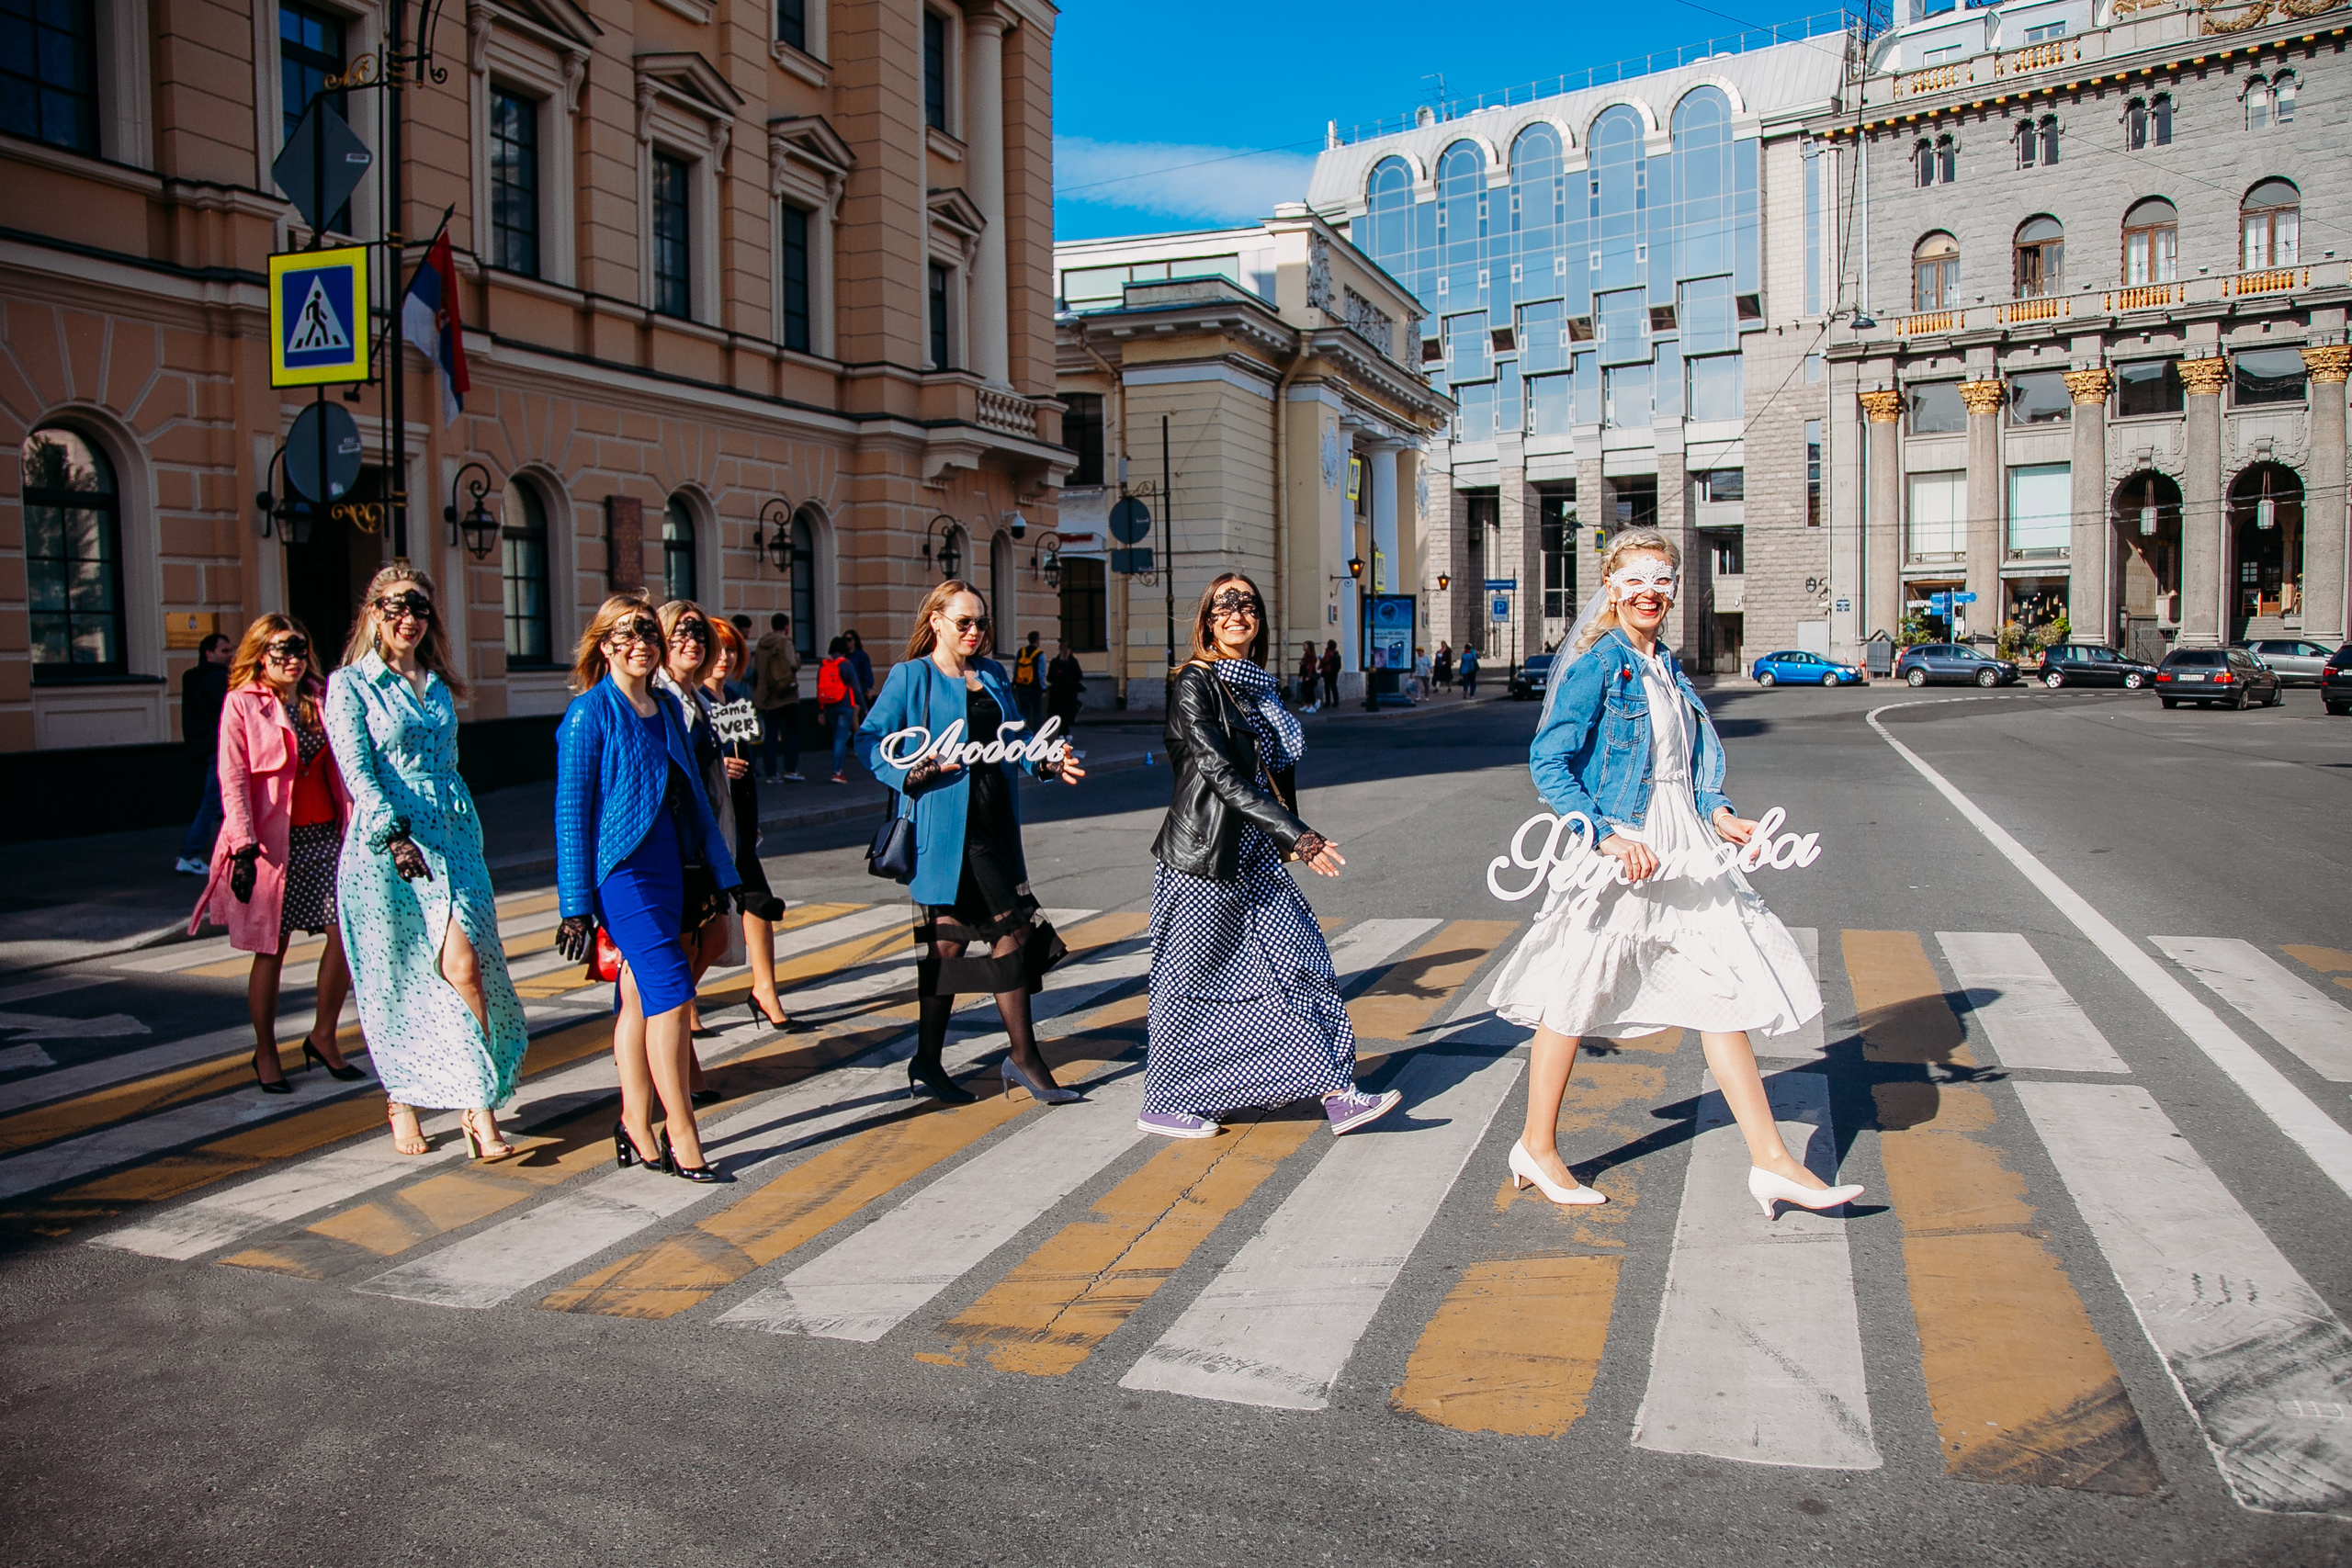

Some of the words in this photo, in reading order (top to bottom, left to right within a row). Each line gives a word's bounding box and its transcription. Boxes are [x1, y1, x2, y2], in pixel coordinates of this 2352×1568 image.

[1497, 602, 1505, 613] P
[710, 705, 748, 719] Game
[879, 715, 1066, 769] Любовь
